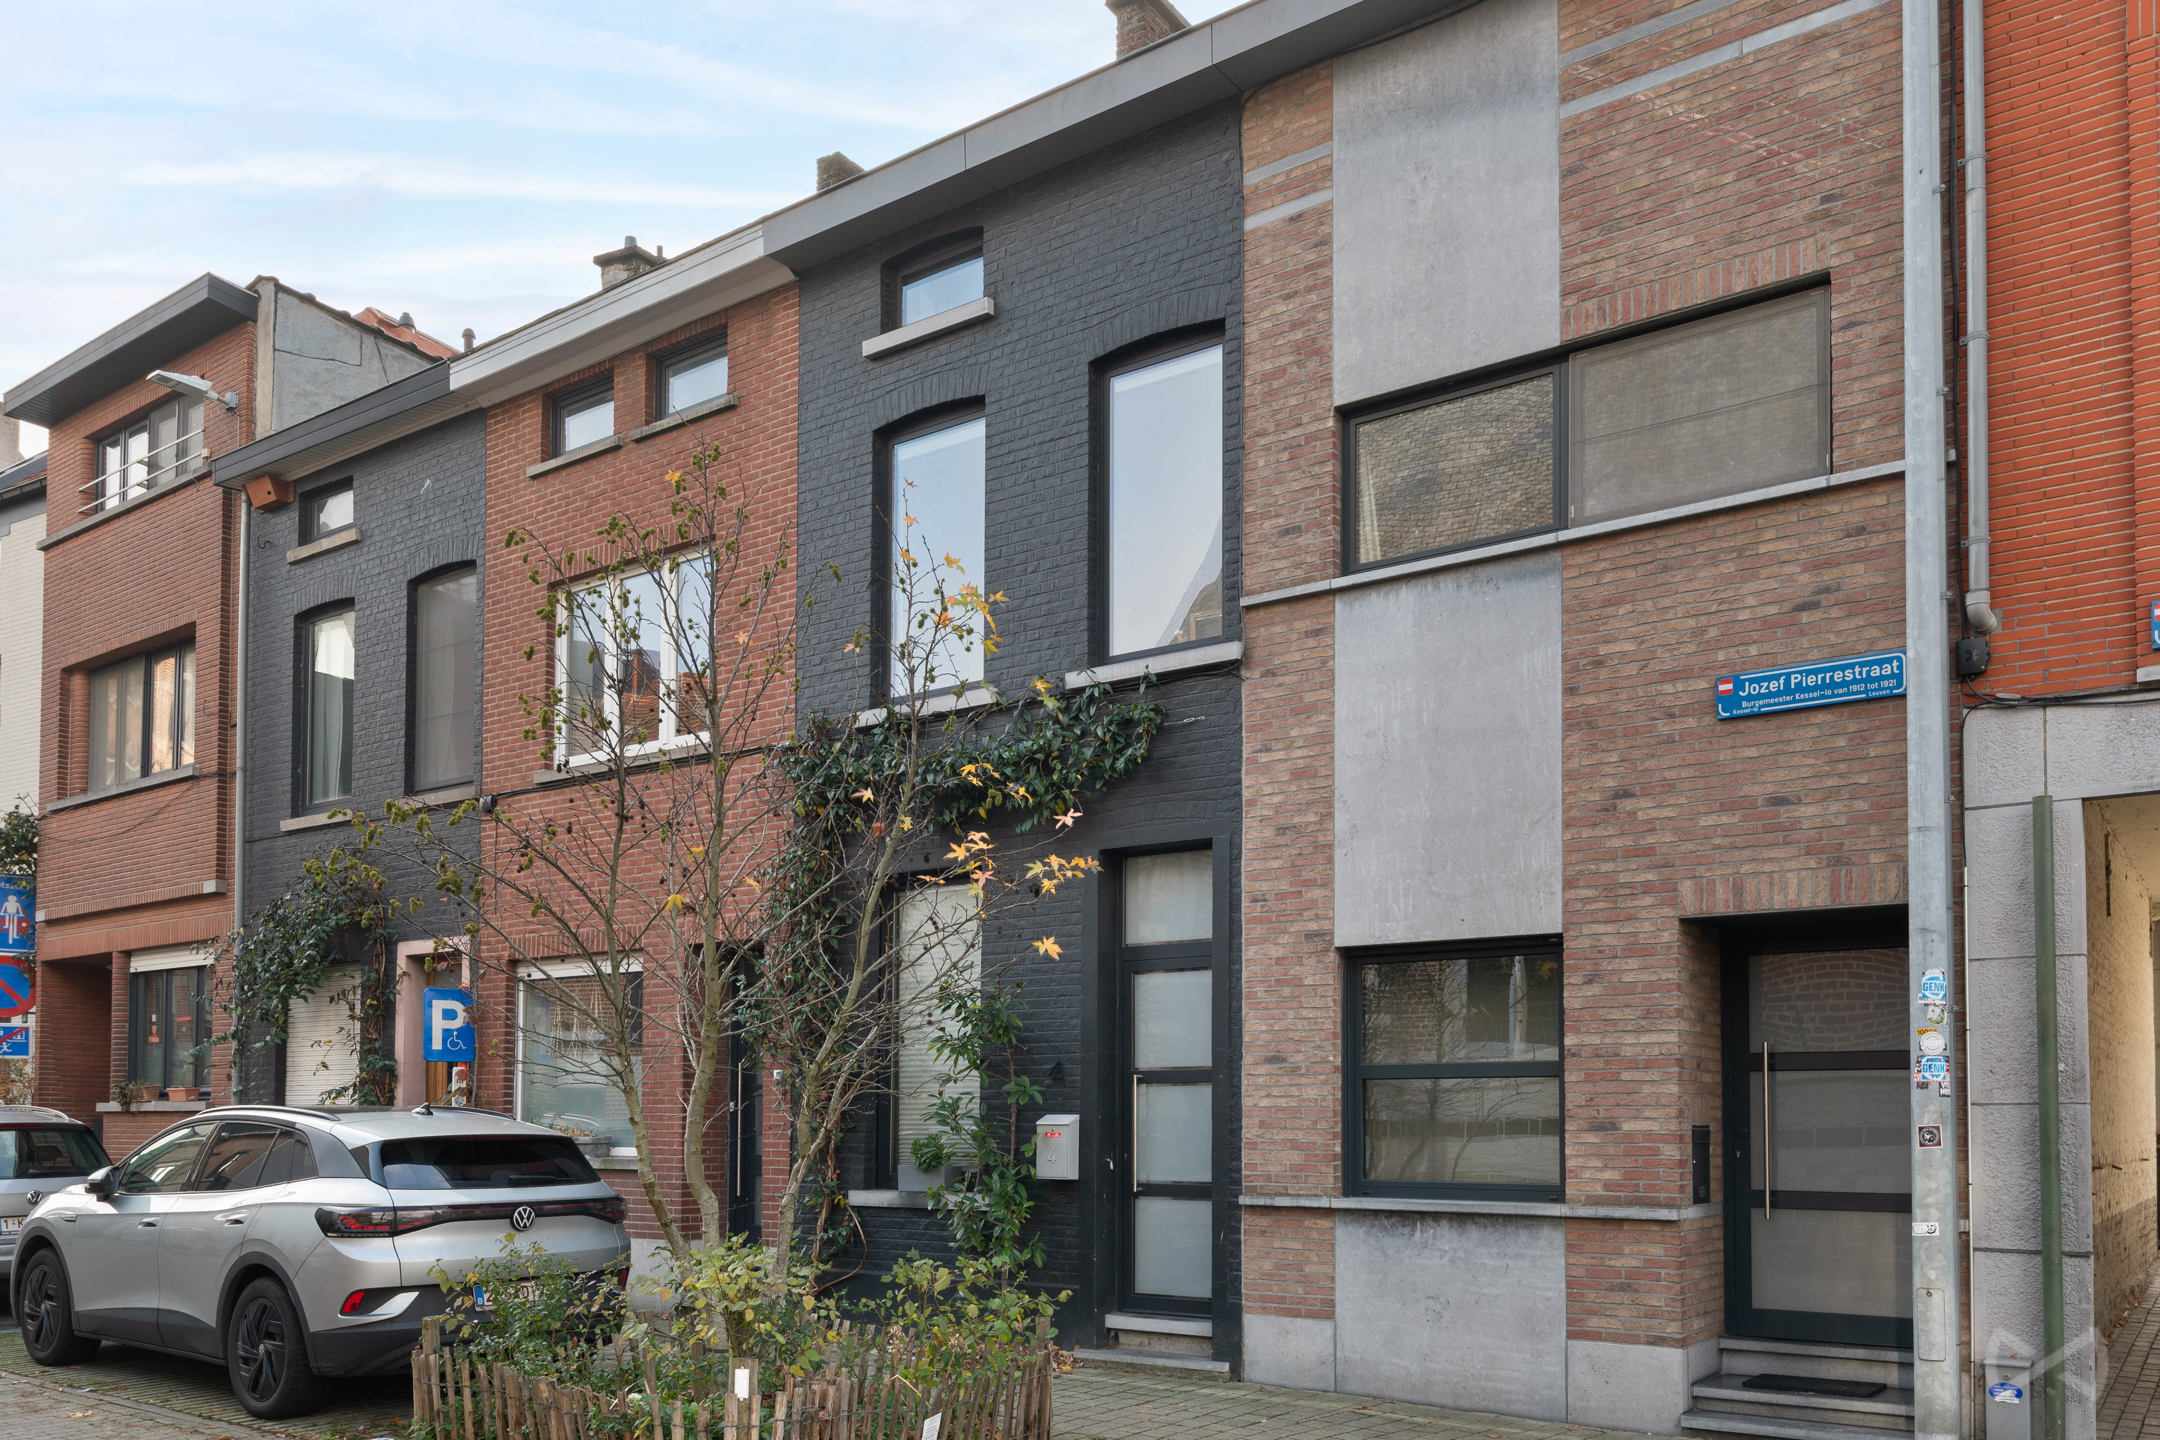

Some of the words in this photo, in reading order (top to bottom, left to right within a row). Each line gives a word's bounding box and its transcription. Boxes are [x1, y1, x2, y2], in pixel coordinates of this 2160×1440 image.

[1739, 675, 1786, 697] Jozef
[1790, 659, 1900, 689] Pierrestraat
[1742, 694, 1794, 709] Burgemeester
[1795, 689, 1832, 701] Kessel-lo
[1834, 687, 1848, 695] van
[1849, 683, 1865, 693] 1912
[1867, 681, 1879, 690] tot
[1880, 679, 1897, 688] 1921
[1868, 689, 1891, 697] Leuven
[1922, 981, 1945, 993] GENK
[431, 999, 466, 1050] P
[1922, 1063, 1946, 1074] GENK
